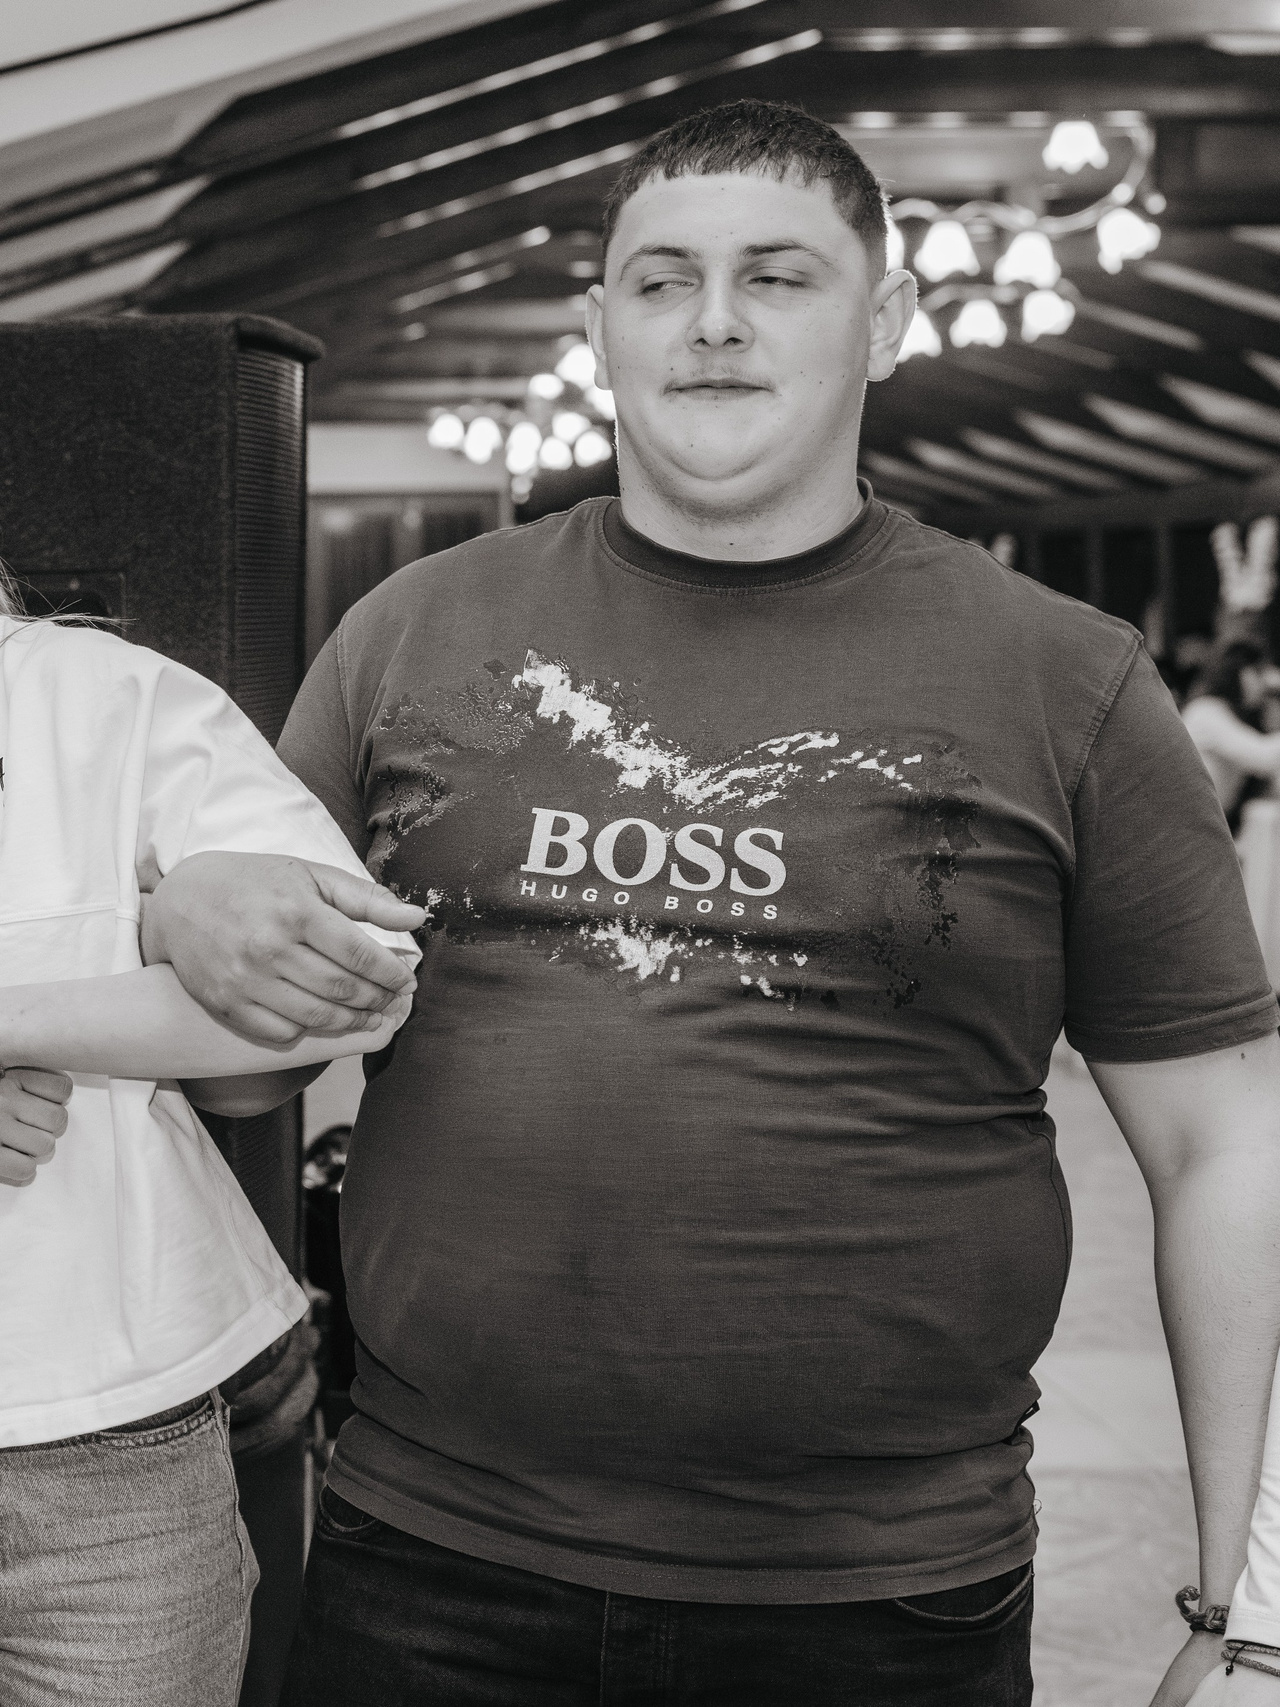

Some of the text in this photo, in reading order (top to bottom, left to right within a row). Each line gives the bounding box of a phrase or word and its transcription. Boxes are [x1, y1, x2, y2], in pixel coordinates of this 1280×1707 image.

[519, 806, 787, 897] BOSS
[520, 879, 778, 920] HUGO BOSS
